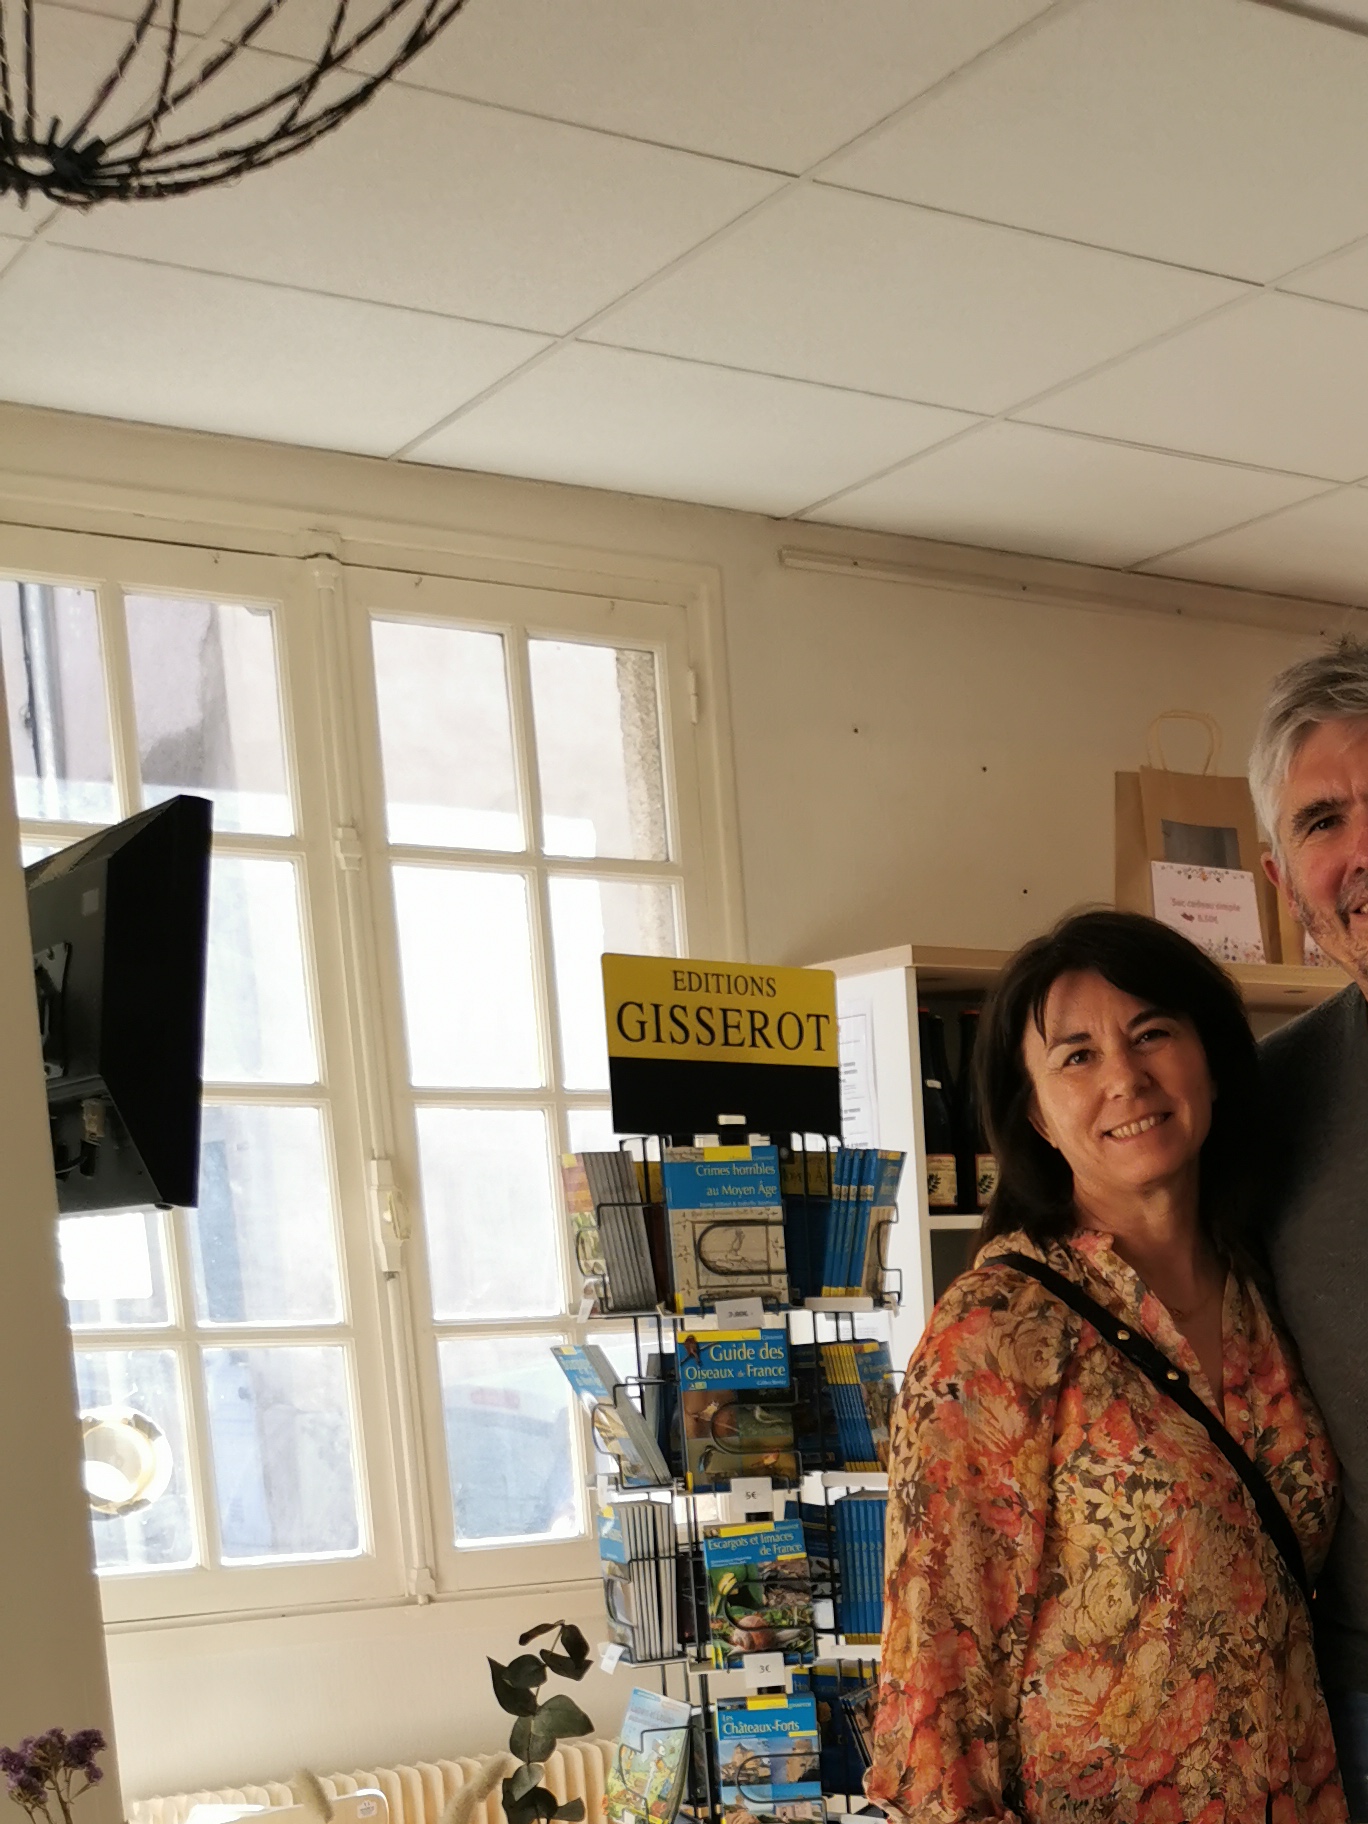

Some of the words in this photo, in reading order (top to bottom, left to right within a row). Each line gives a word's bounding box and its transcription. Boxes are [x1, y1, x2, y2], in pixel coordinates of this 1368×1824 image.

[672, 970, 777, 998] EDITIONS
[616, 1001, 831, 1052] GISSEROT
[695, 1164, 731, 1178] Crimes
[731, 1162, 776, 1176] horribles
[706, 1187, 720, 1197] au
[721, 1184, 756, 1199] Moyen
[757, 1180, 778, 1198] Âge
[709, 1342, 756, 1362] Guide
[759, 1341, 785, 1361] des
[685, 1366, 735, 1381] Oiseaux
[745, 1363, 787, 1378] France
[745, 1491, 758, 1500] 5€
[707, 1537, 750, 1551] Escargots
[749, 1536, 760, 1546] et
[760, 1532, 794, 1544] limaces
[759, 1545, 773, 1556] de
[773, 1543, 803, 1554] France
[759, 1664, 772, 1674] 3€
[722, 1714, 734, 1722] Les
[722, 1719, 800, 1735] Châteaux-Forts
